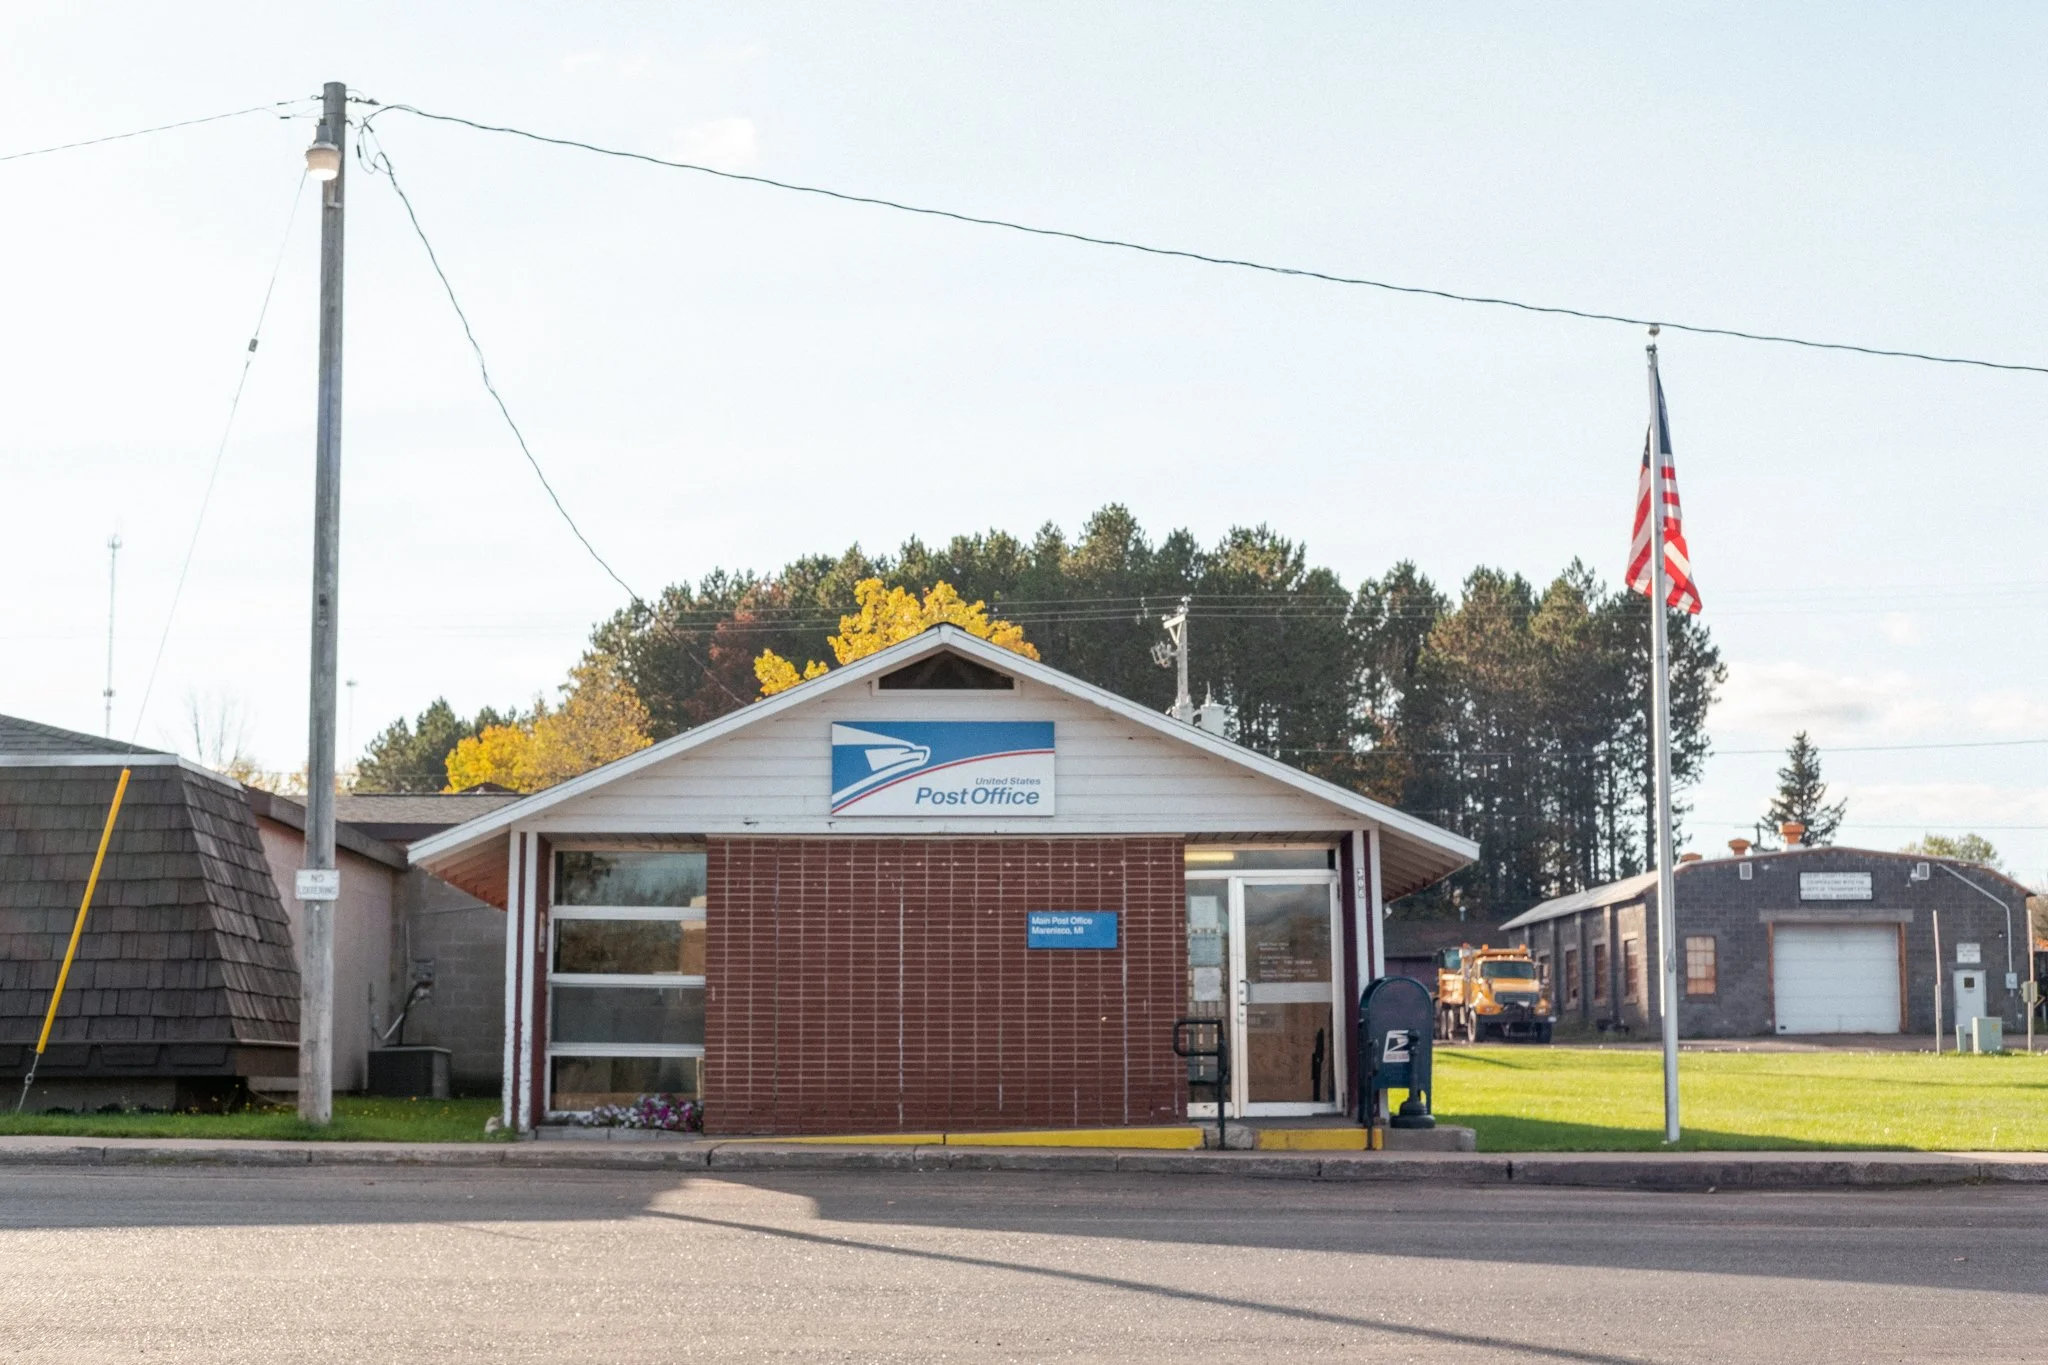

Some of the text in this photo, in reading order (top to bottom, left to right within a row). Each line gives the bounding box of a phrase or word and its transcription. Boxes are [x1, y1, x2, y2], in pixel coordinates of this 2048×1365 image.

[975, 777, 1041, 785] United States
[915, 787, 1040, 805] Post Office
[311, 873, 325, 883] NO
[1031, 916, 1093, 925] Main Post Office
[1073, 926, 1084, 935] MI
